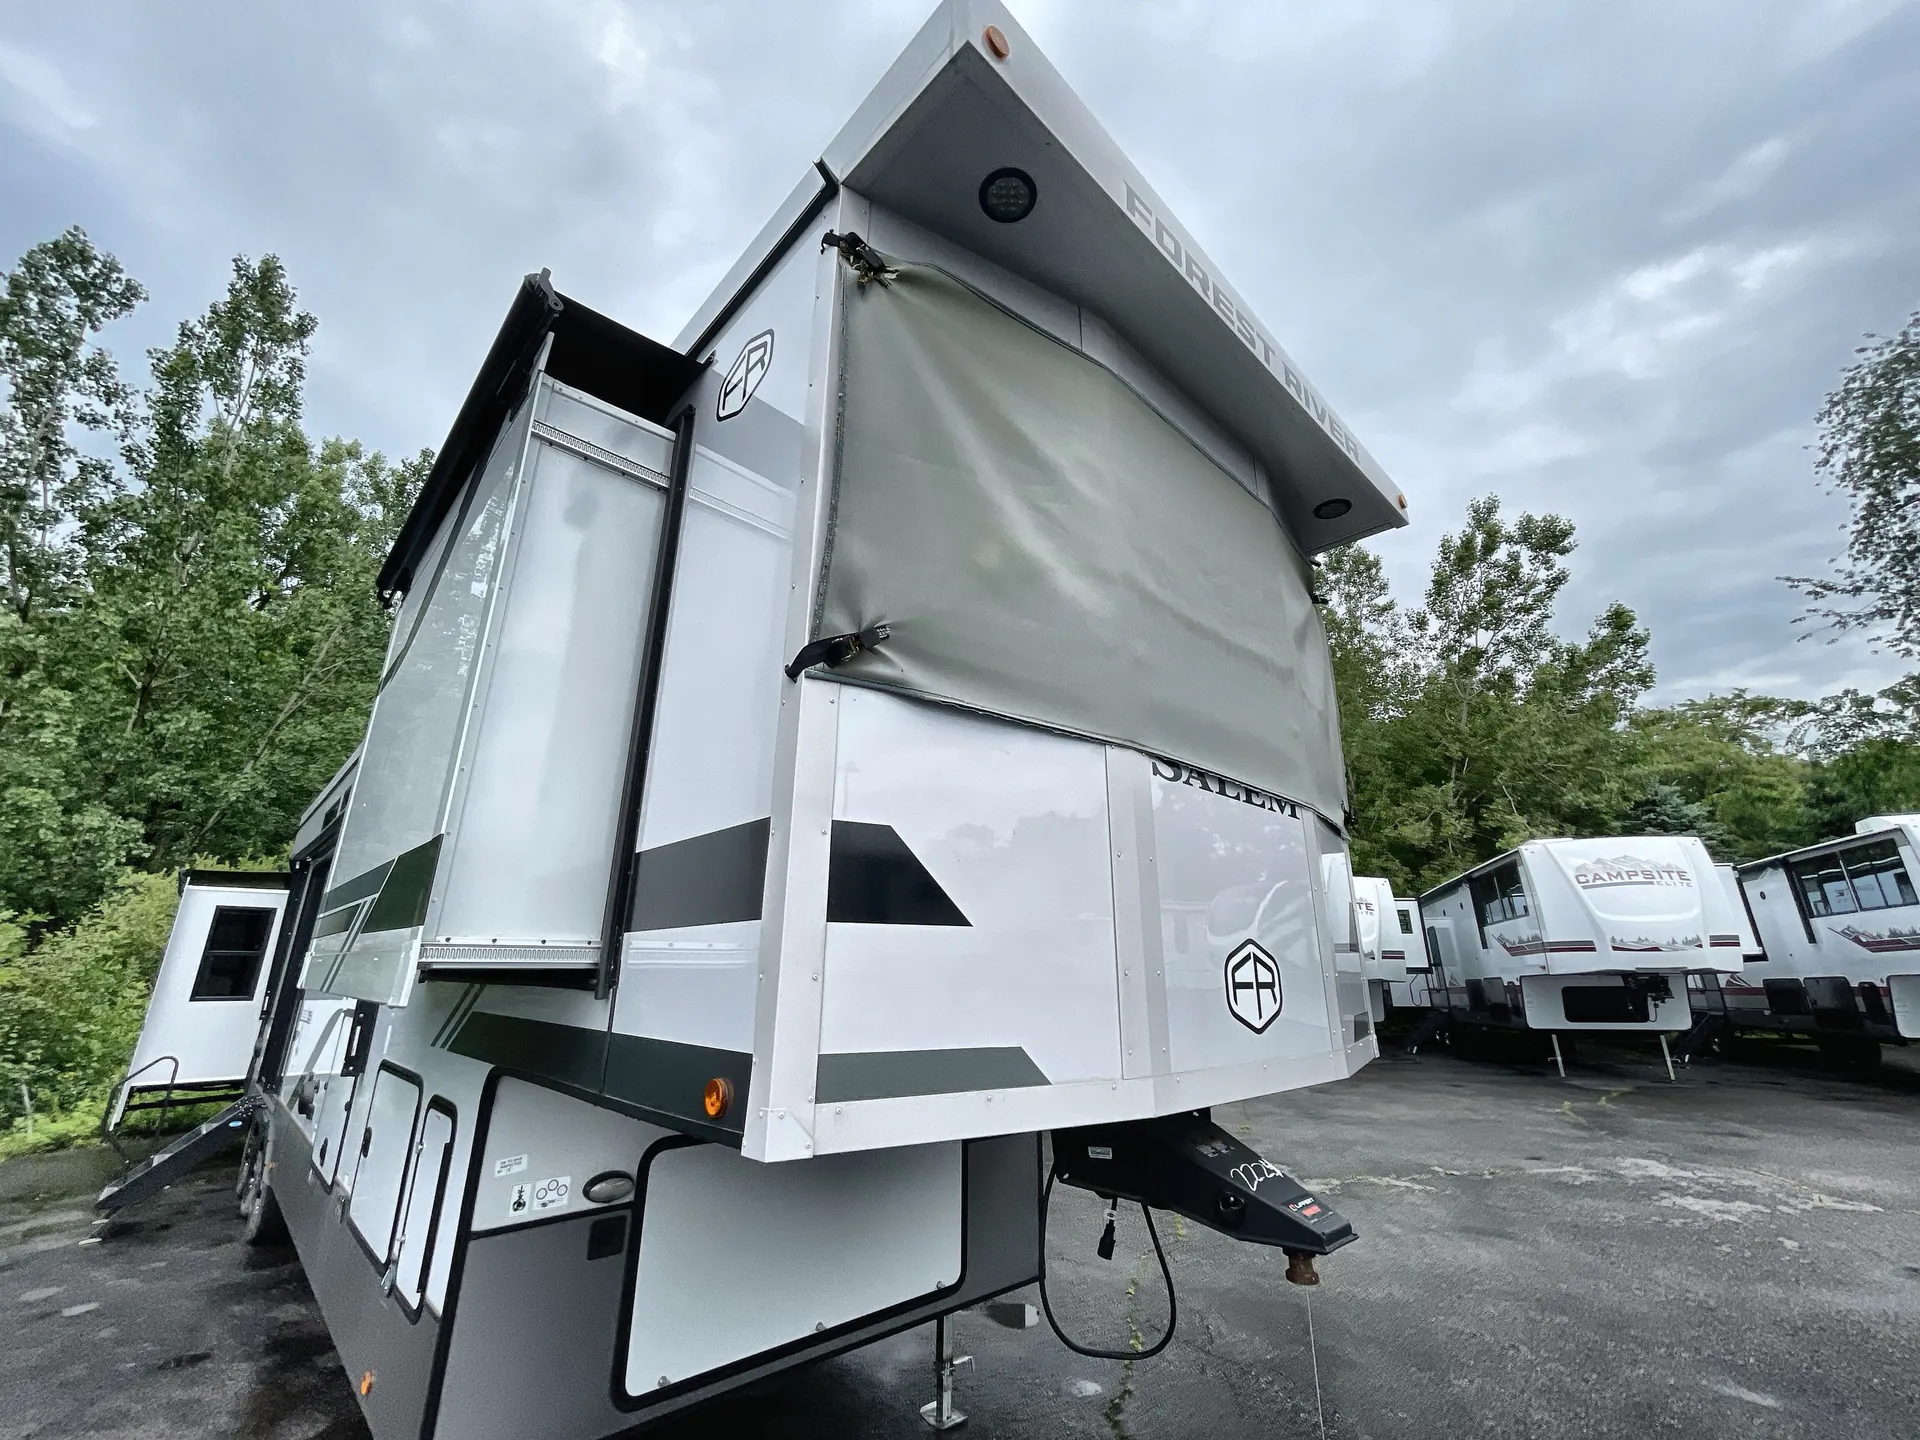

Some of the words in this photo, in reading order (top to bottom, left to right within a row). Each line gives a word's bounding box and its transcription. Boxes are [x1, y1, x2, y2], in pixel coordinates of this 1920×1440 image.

[1123, 179, 1276, 366] FOREST
[1282, 360, 1361, 463] RIVER
[1575, 869, 1691, 885] CAMPSITE
[1655, 880, 1694, 888] ELITE
